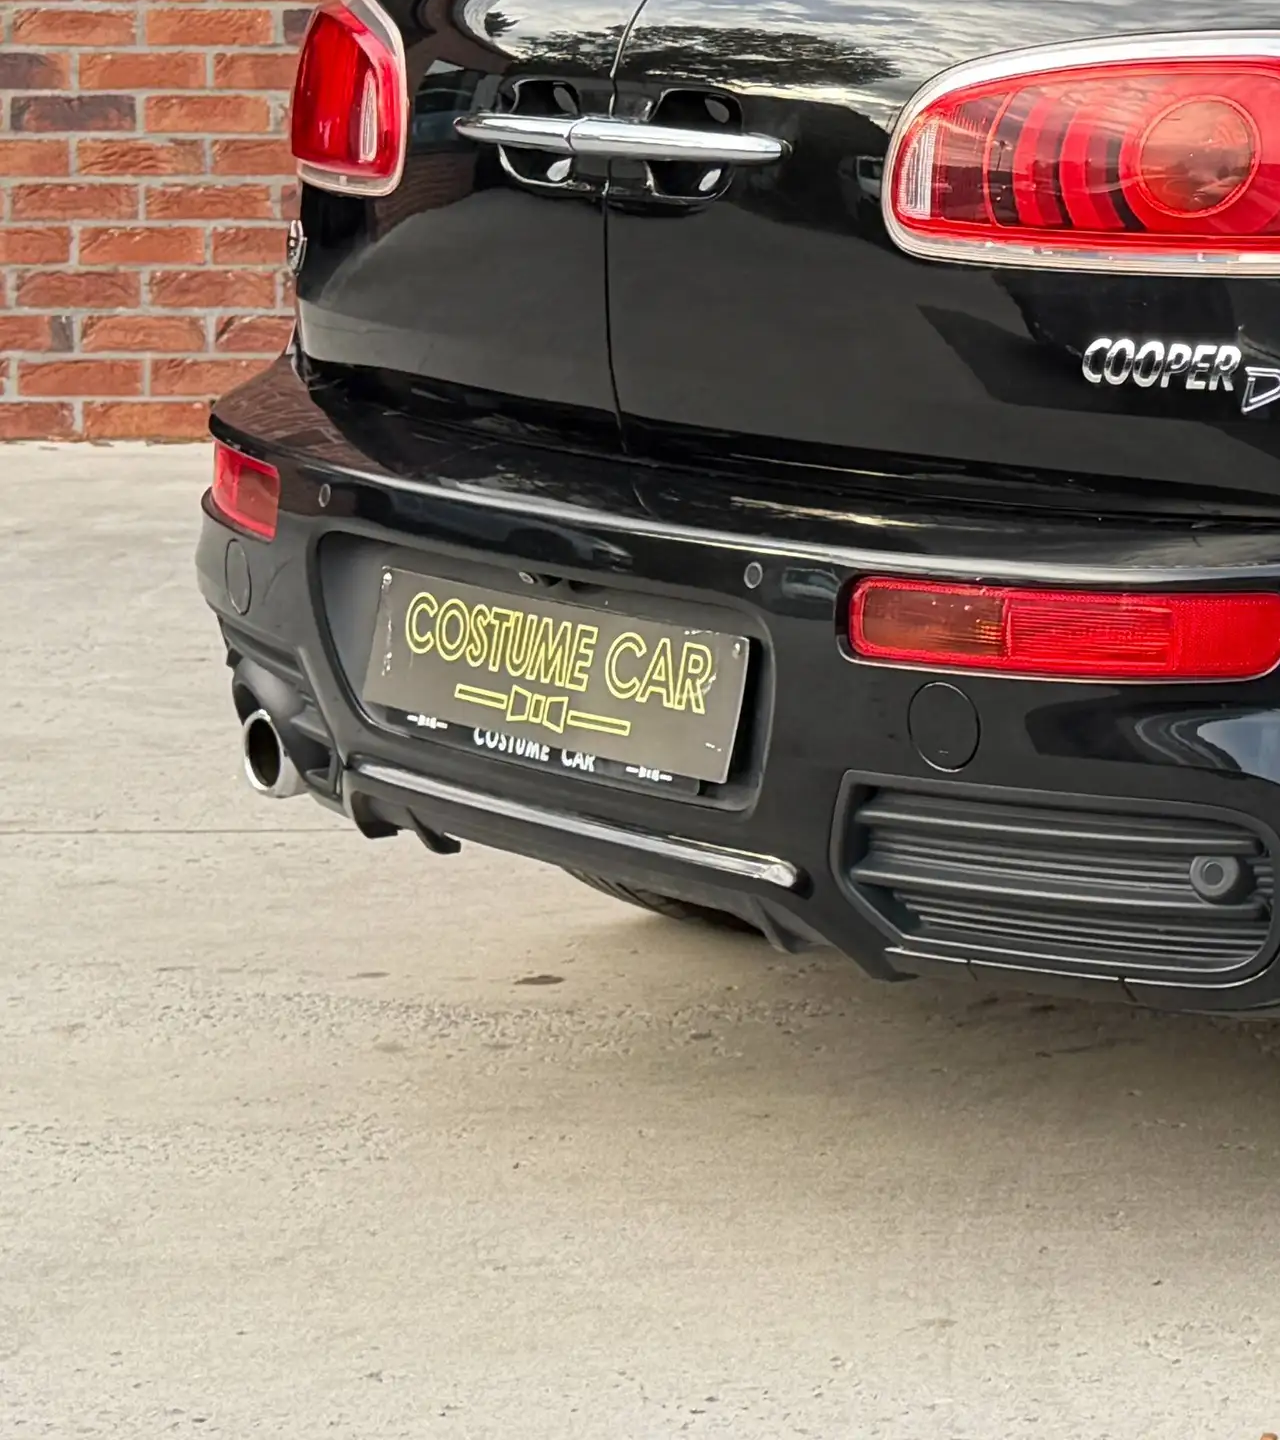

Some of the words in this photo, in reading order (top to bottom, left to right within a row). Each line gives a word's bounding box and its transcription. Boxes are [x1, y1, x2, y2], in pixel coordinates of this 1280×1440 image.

[1081, 337, 1242, 392] COOPER
[405, 591, 599, 692] COSTUME
[604, 631, 712, 715] CAR
[473, 726, 550, 762] COSTUME
